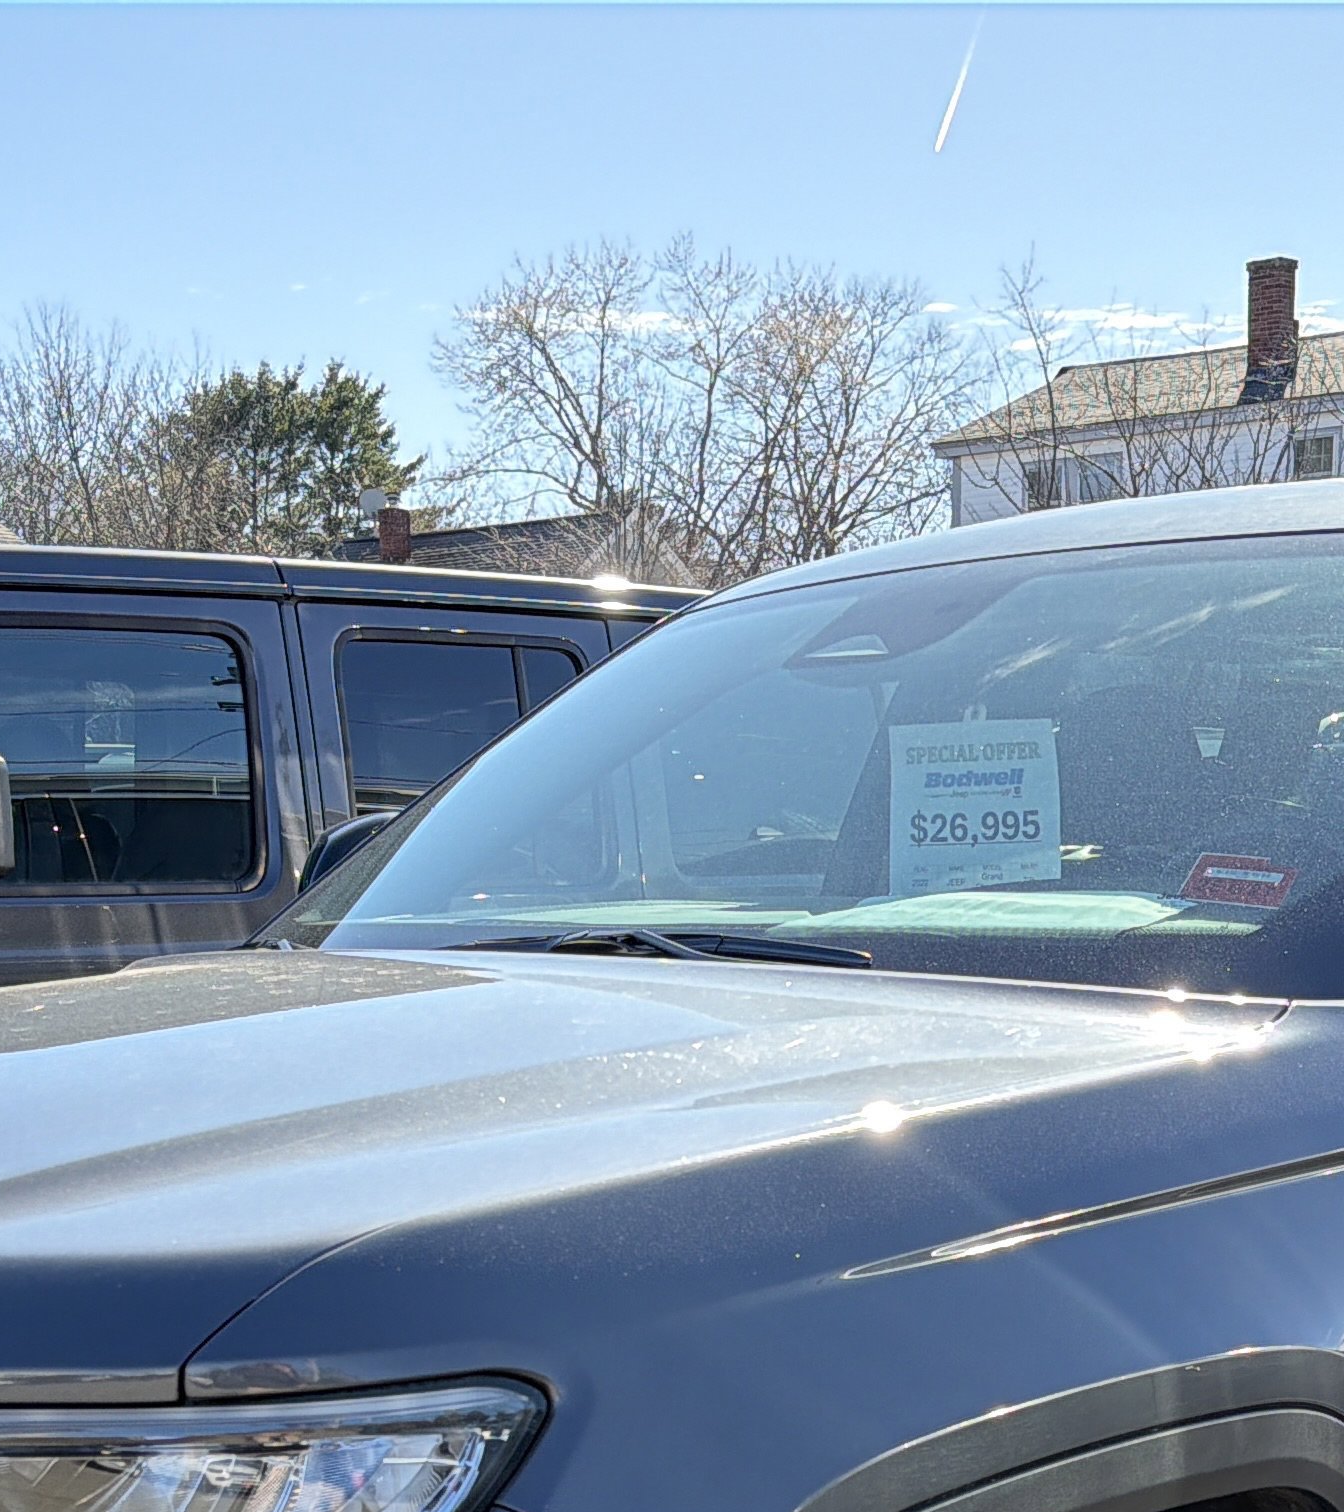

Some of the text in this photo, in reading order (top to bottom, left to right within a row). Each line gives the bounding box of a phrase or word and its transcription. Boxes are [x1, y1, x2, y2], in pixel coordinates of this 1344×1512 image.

[906, 742, 1042, 765] SPECIAL OFFER
[924, 768, 1024, 788] Bodwell
[910, 809, 1041, 848] $26,995
[981, 872, 1003, 880] Grand
